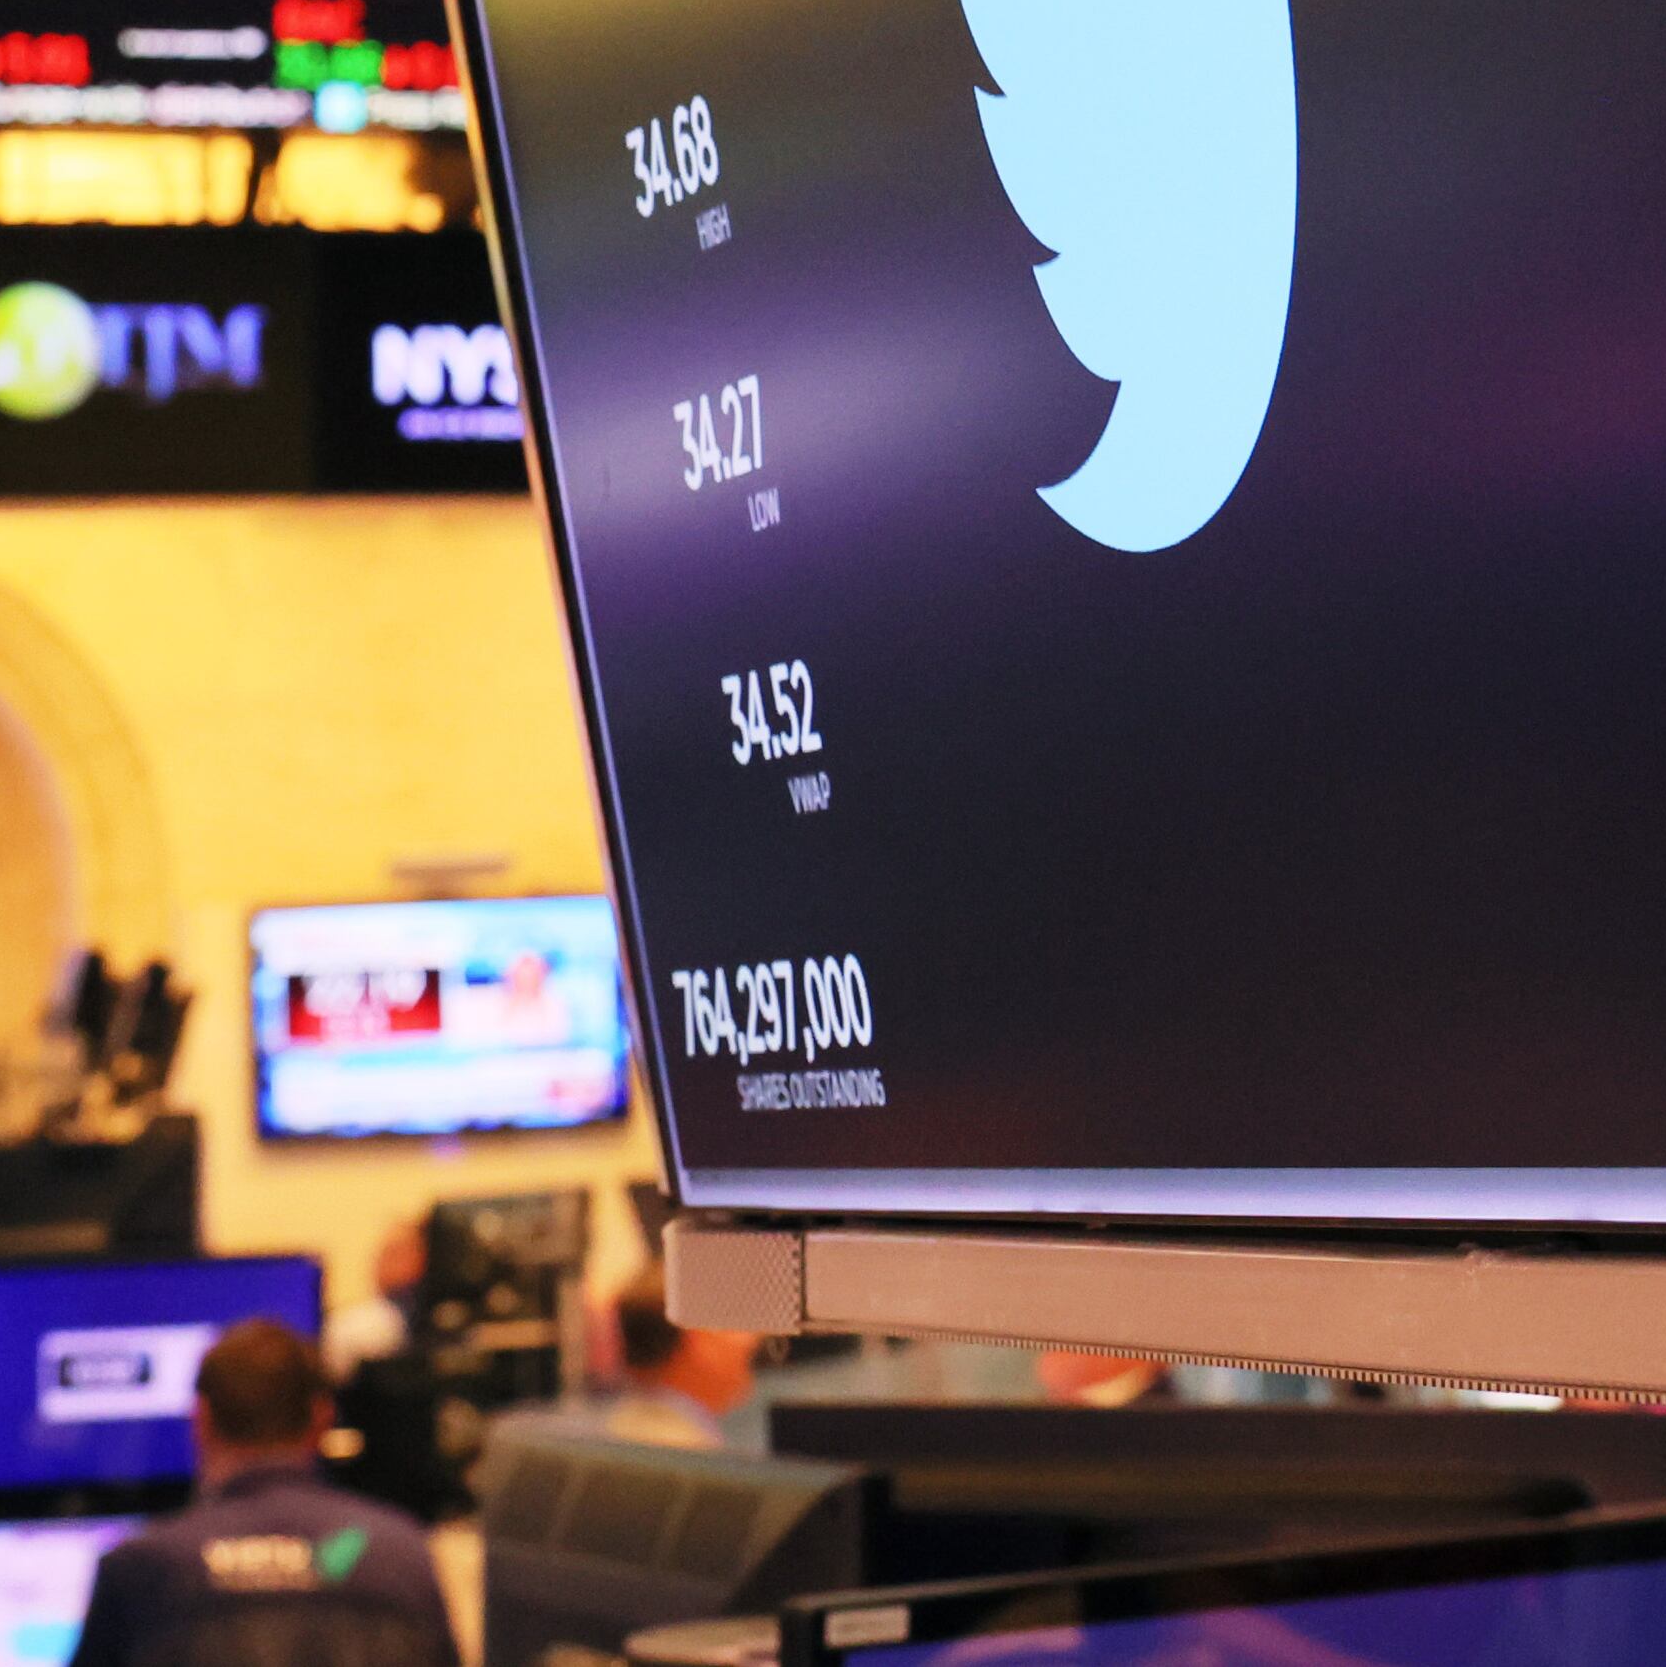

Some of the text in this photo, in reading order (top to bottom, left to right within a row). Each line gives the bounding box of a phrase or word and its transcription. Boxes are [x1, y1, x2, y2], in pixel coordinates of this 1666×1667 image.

[625, 95, 720, 218] 34.68
[695, 203, 732, 251] HIGH
[673, 374, 763, 491] 34.27
[748, 487, 781, 532] LOW
[721, 659, 822, 765] 34.52
[787, 772, 831, 814] VWAP
[672, 954, 872, 1067] 764,297,000
